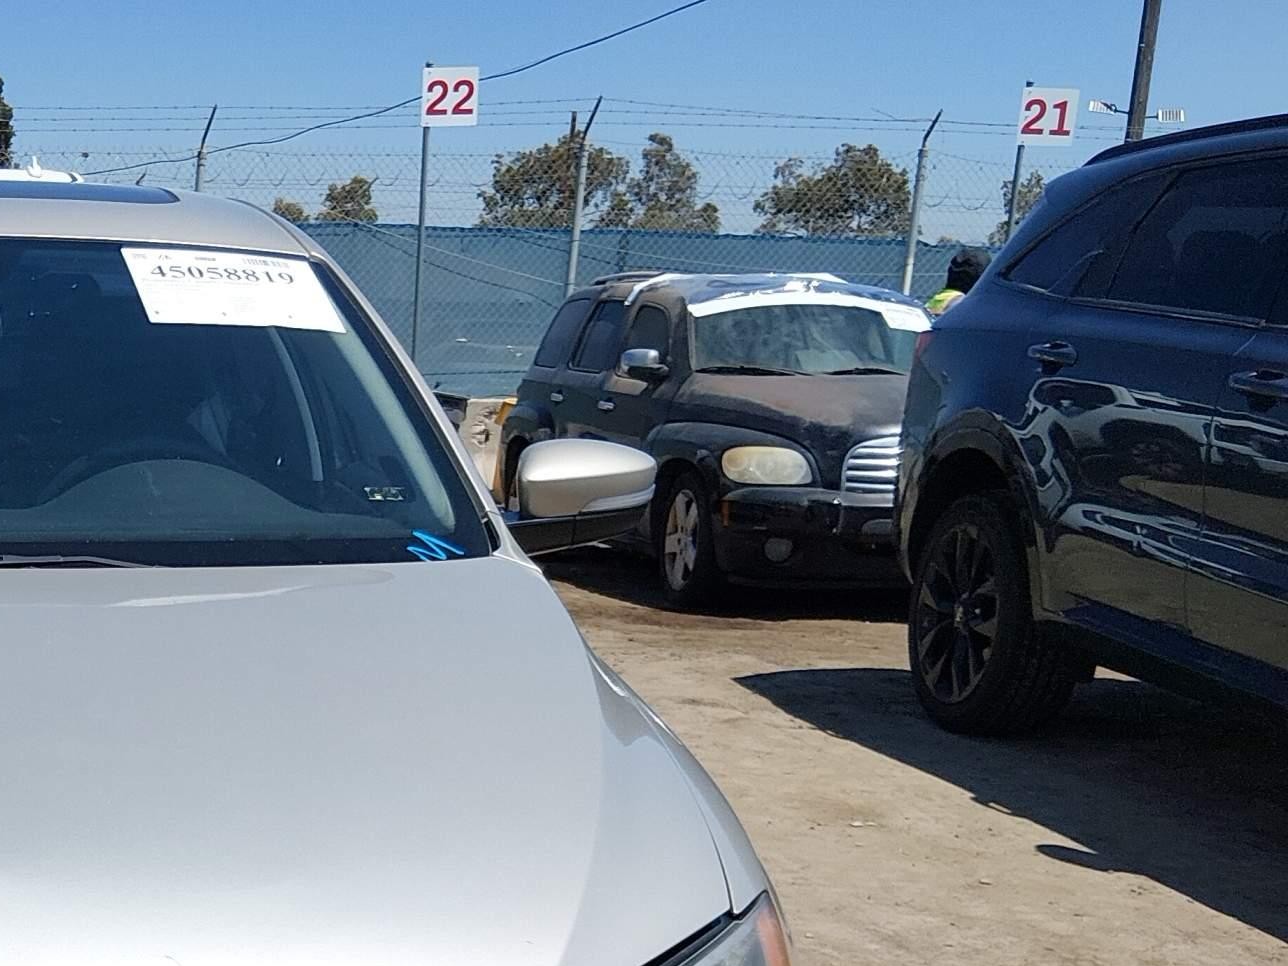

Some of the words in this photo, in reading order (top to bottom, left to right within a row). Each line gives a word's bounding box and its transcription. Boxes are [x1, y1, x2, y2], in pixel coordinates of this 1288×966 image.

[426, 78, 475, 115] 22
[1021, 98, 1069, 137] 21
[150, 264, 295, 285] 45058819
